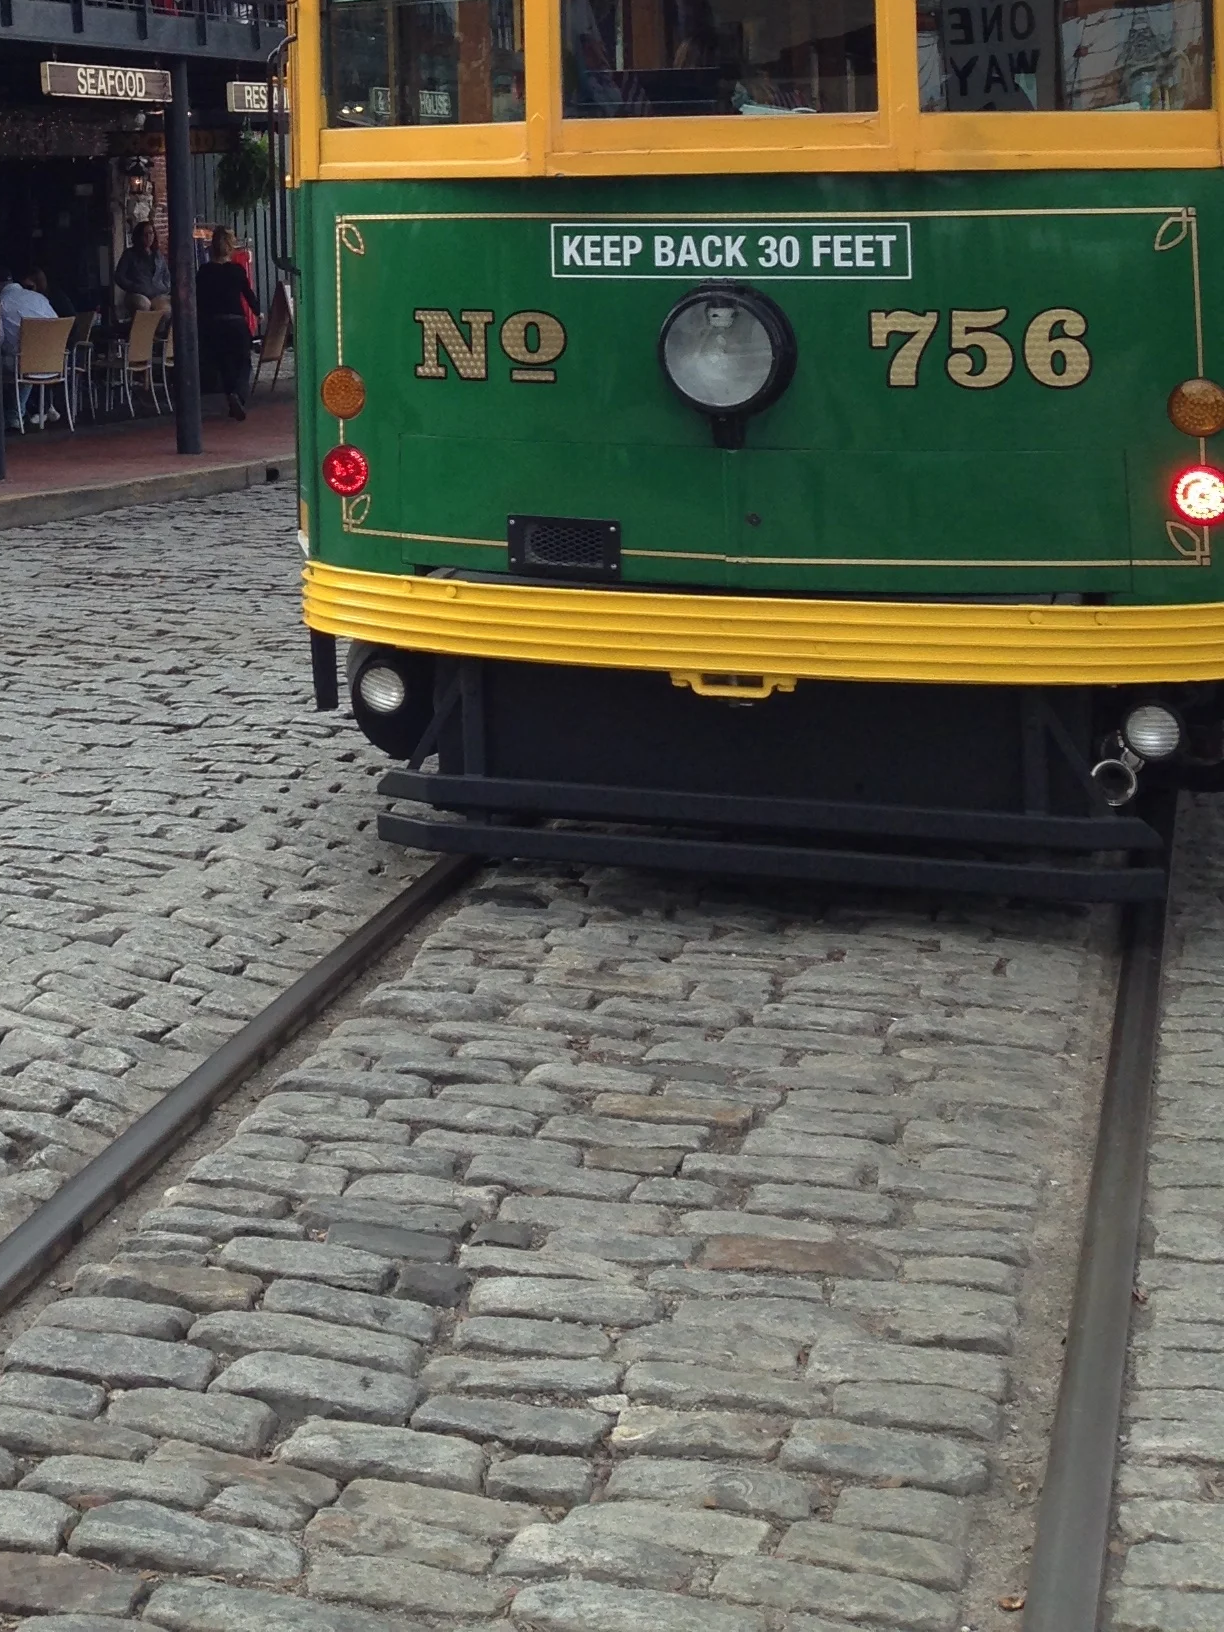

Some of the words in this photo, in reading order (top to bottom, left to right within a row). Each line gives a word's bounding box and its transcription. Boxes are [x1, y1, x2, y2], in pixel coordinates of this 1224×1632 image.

[77, 66, 146, 98] SEAFOOD
[419, 94, 450, 115] HOUSE
[562, 233, 644, 268] KEEP
[654, 233, 747, 268] BACK
[757, 233, 801, 268] 30
[812, 232, 898, 268] FEET
[867, 306, 1093, 390] 756
